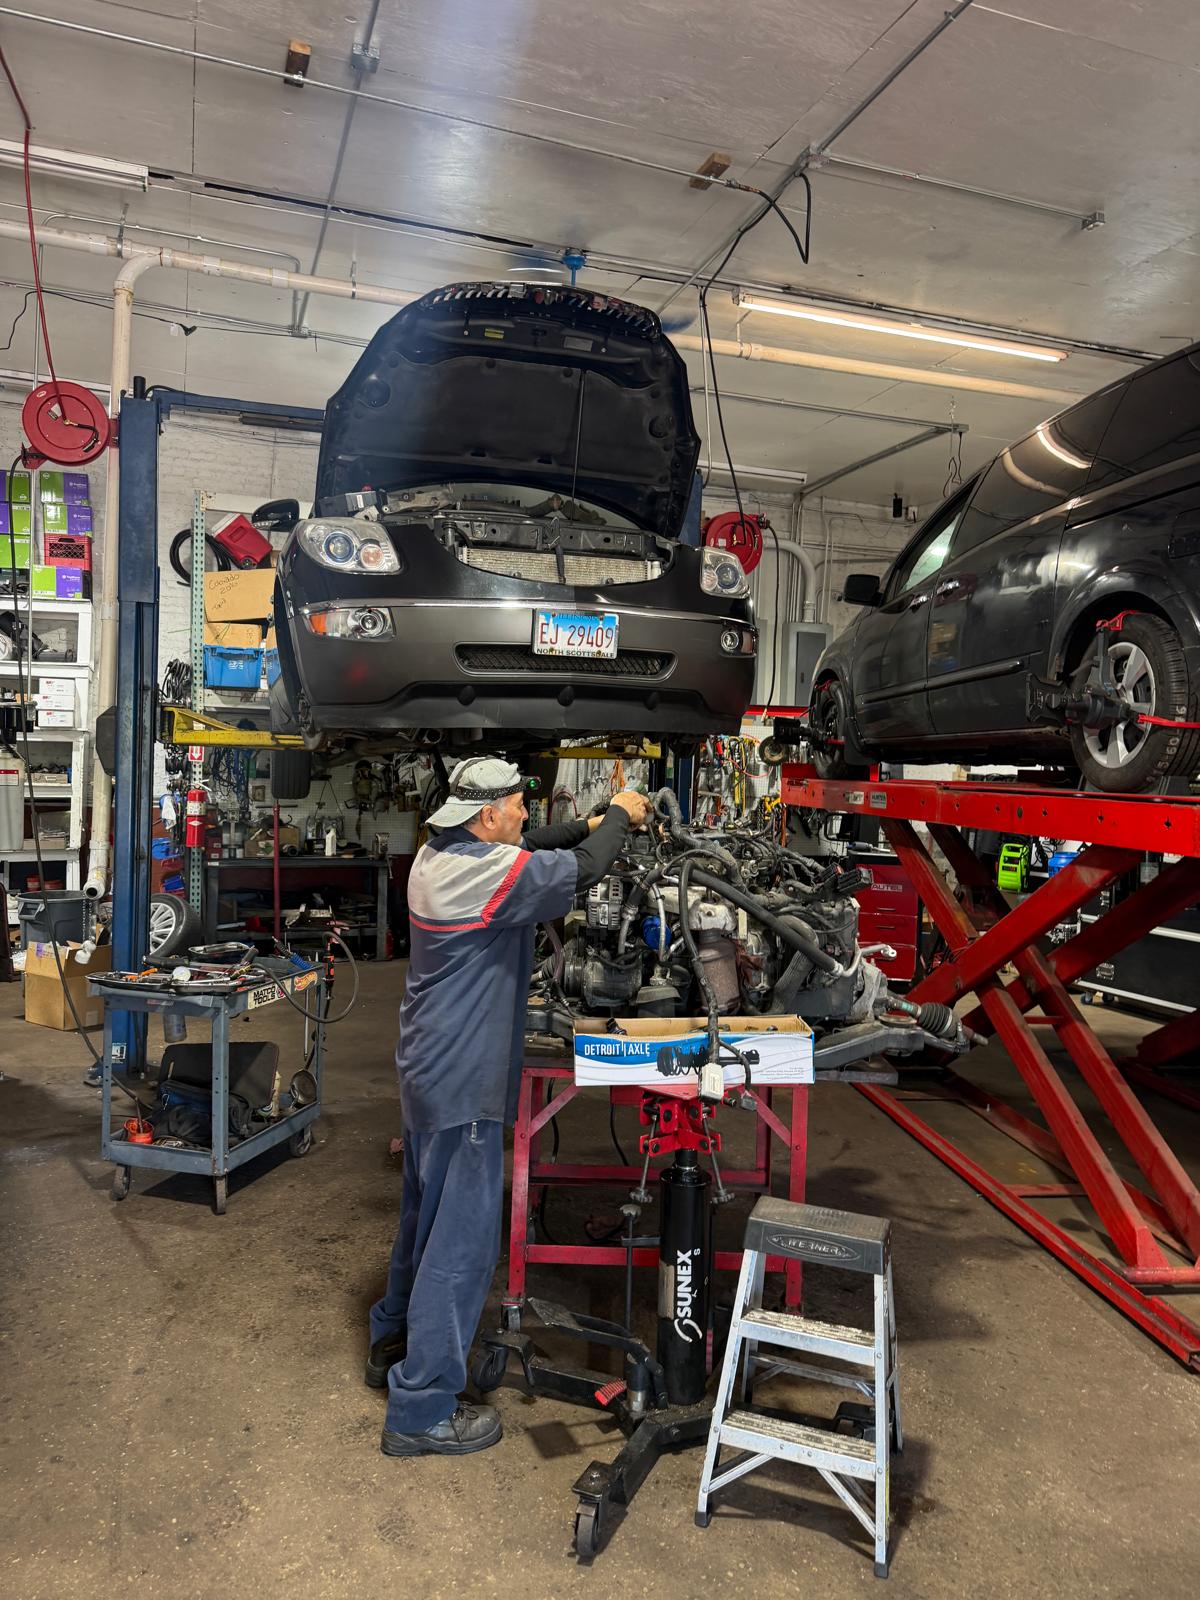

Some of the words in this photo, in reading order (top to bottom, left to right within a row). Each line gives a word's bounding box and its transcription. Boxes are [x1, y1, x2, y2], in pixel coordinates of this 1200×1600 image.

[540, 623, 559, 645] EJ
[567, 625, 614, 648] 29409
[537, 648, 564, 656] NORTH
[566, 649, 615, 658] SCOTTSDALE
[872, 884, 903, 892] AUTEL
[254, 985, 276, 998] MATCO
[253, 993, 276, 1005] TOOLS
[584, 1043, 621, 1056] DETROIT
[627, 1043, 651, 1056] AXLE
[788, 1239, 839, 1255] WERNER
[676, 1249, 692, 1318] SUNEX
